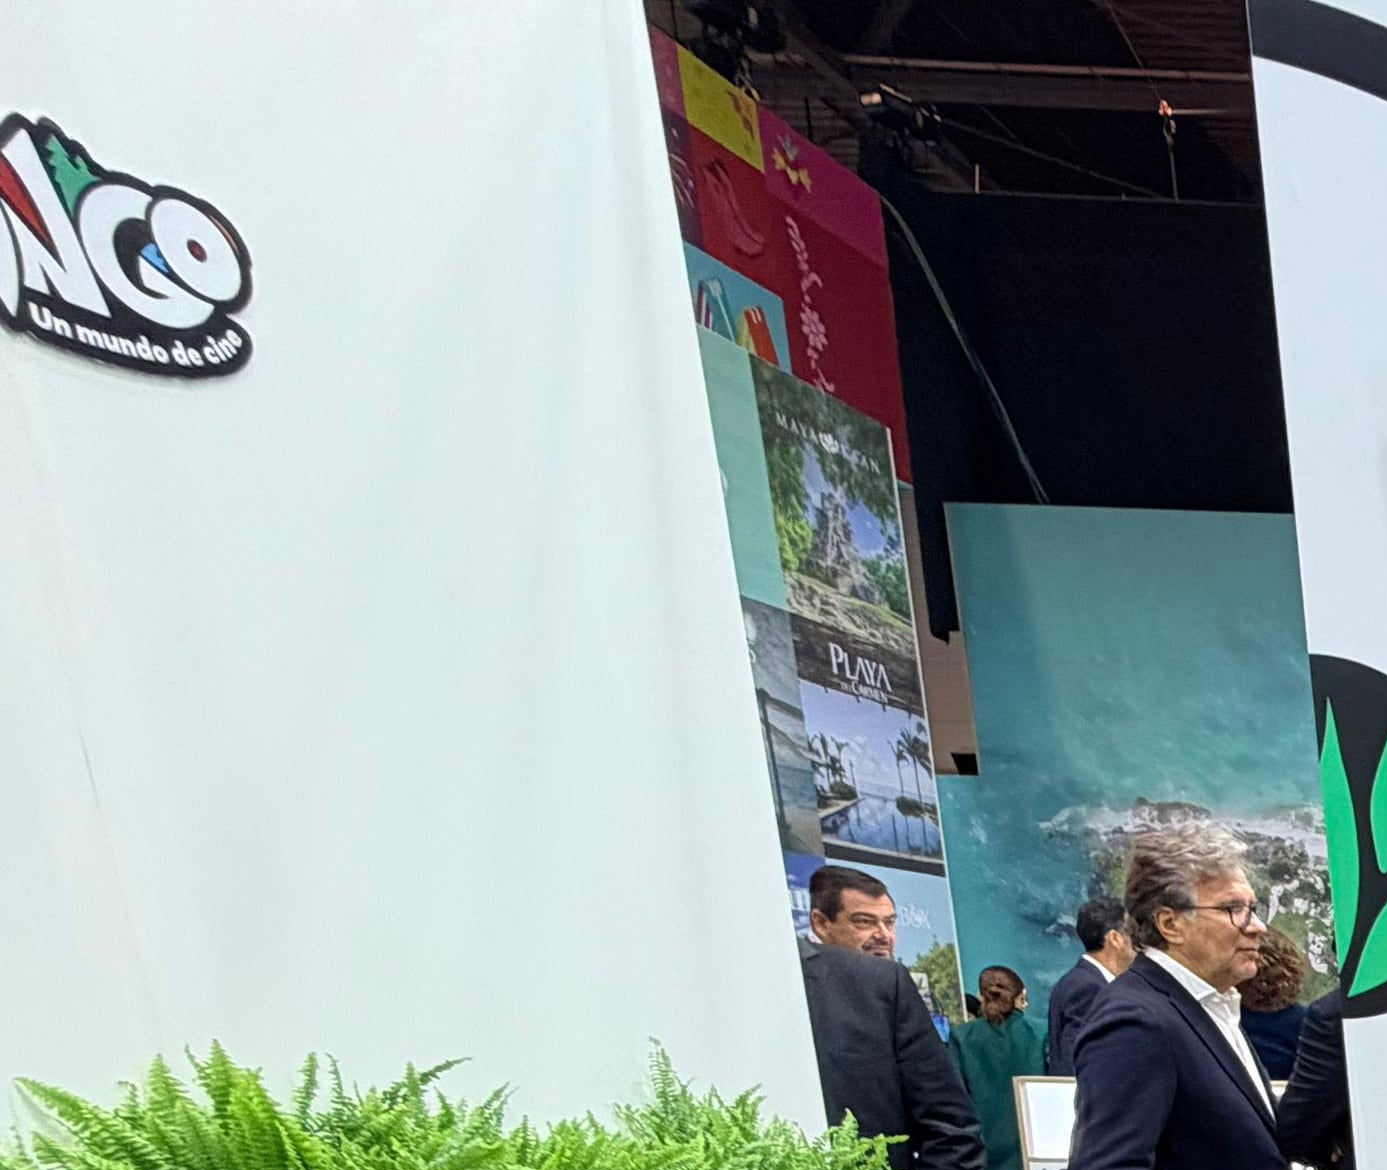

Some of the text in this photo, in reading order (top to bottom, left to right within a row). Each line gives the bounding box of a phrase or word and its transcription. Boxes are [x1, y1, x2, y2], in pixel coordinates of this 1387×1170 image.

[0, 128, 242, 329] NGO
[28, 302, 242, 367] Un mundo de cine
[775, 411, 819, 445] MAYA
[828, 642, 893, 693] PLAYA
